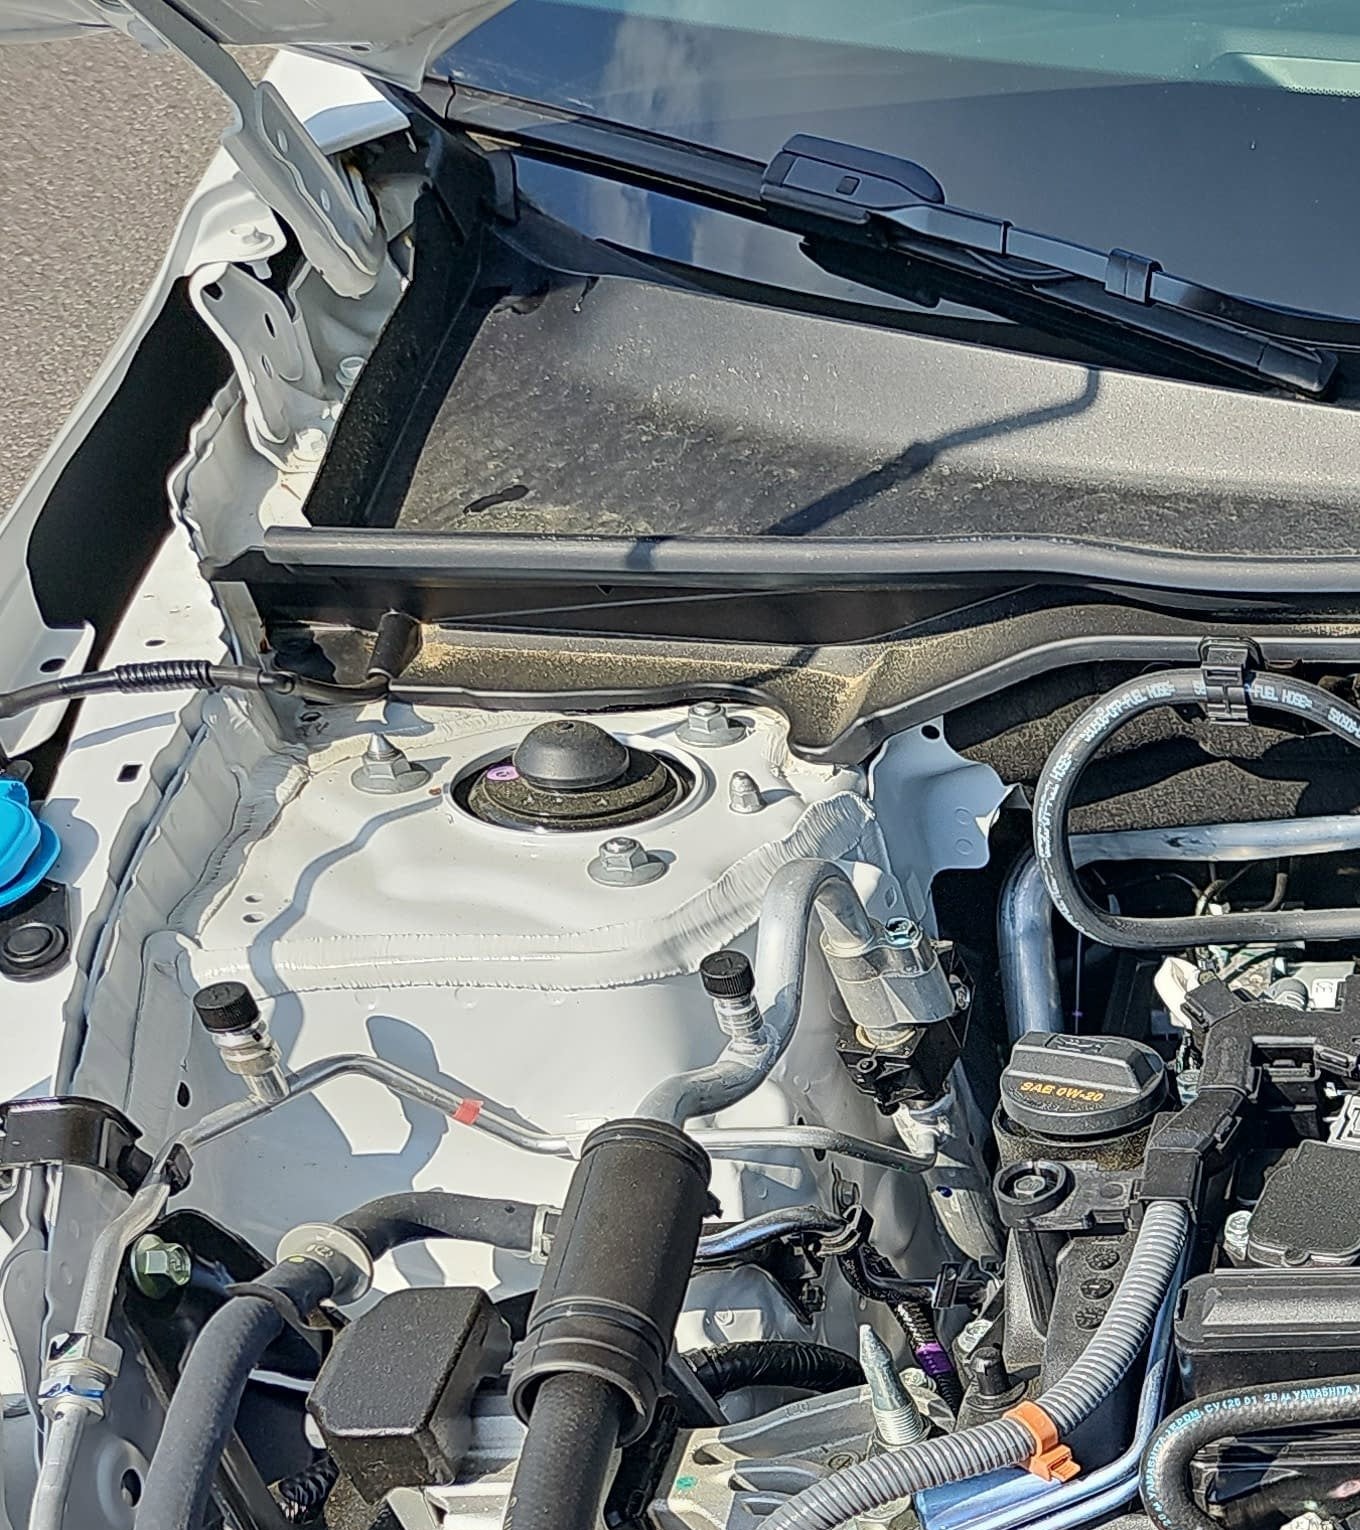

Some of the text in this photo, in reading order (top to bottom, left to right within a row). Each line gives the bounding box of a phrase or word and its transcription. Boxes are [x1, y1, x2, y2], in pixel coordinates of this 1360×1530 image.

[1020, 1082, 1104, 1101] SAE 0W-20
[1292, 1385, 1353, 1401] YAMASHITA
